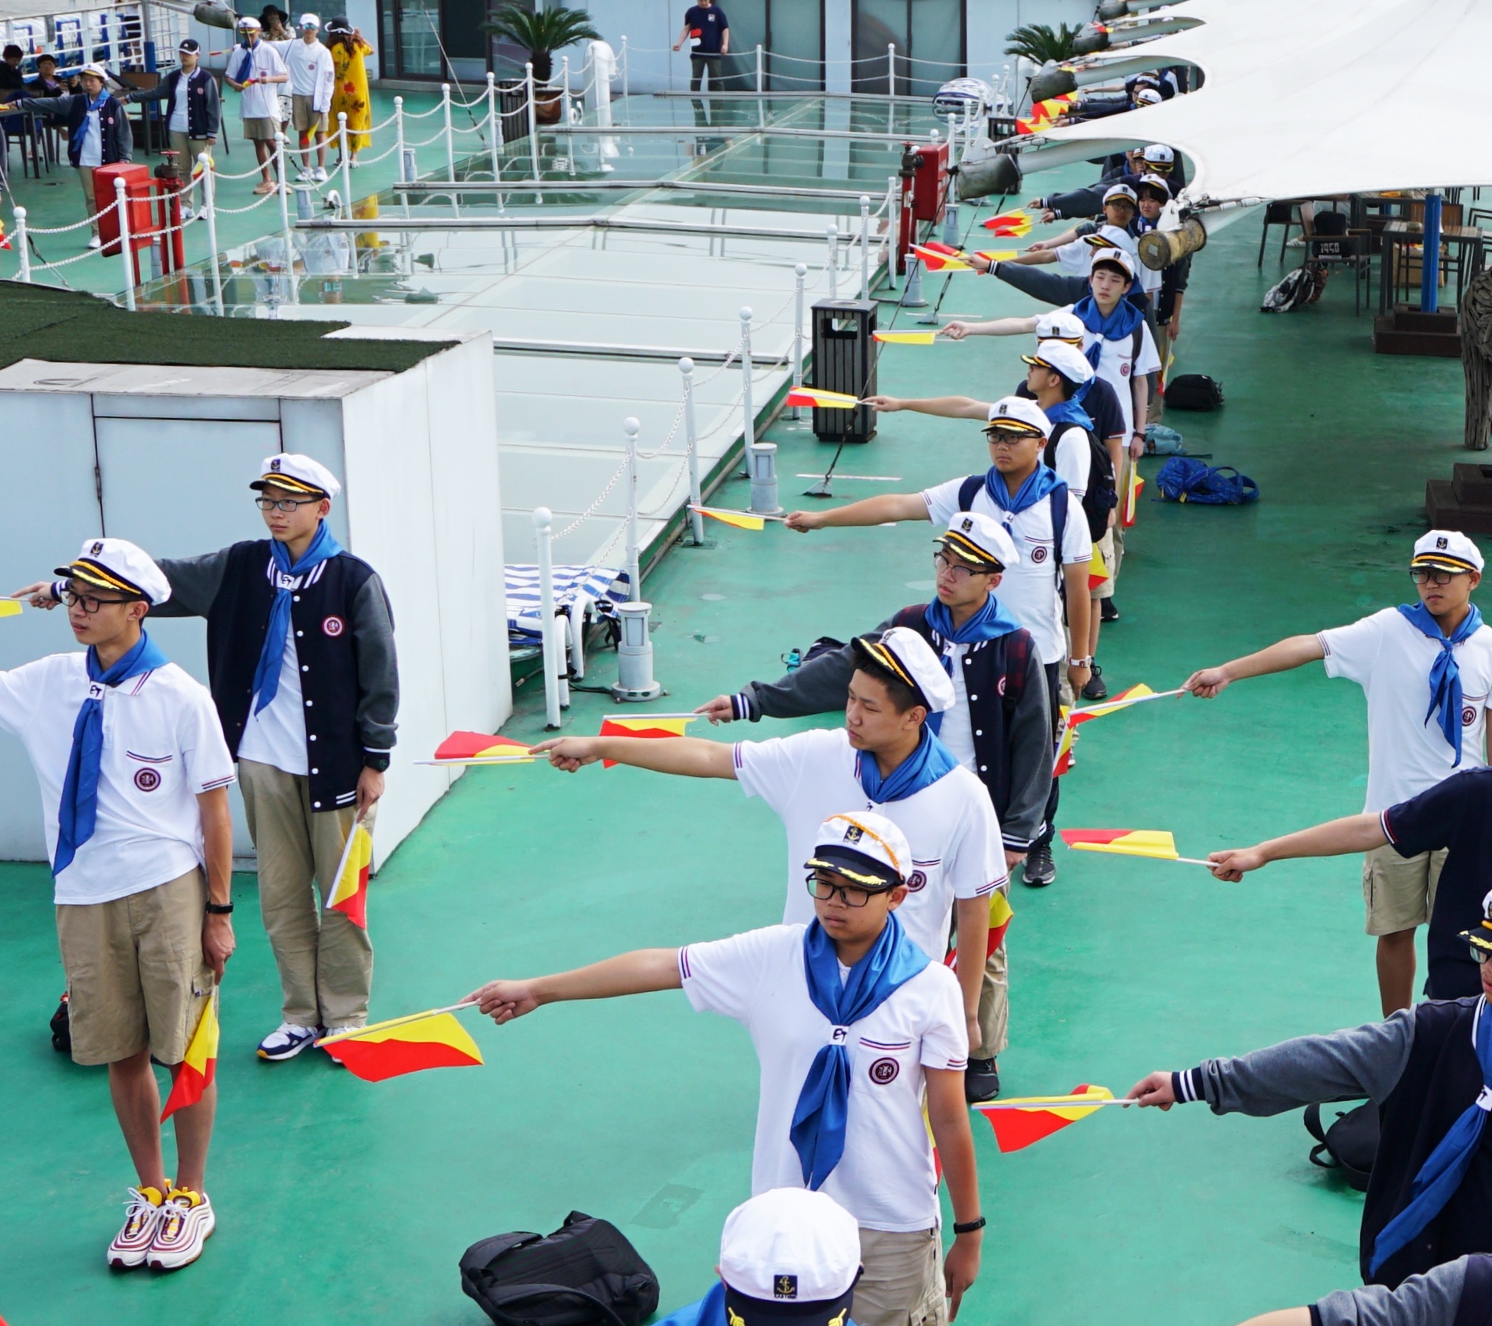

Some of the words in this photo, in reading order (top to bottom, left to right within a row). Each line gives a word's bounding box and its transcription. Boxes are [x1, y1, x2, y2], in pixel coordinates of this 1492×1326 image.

[280, 576, 293, 587] ET
[89, 684, 102, 697] ET
[833, 1028, 847, 1041] ET
